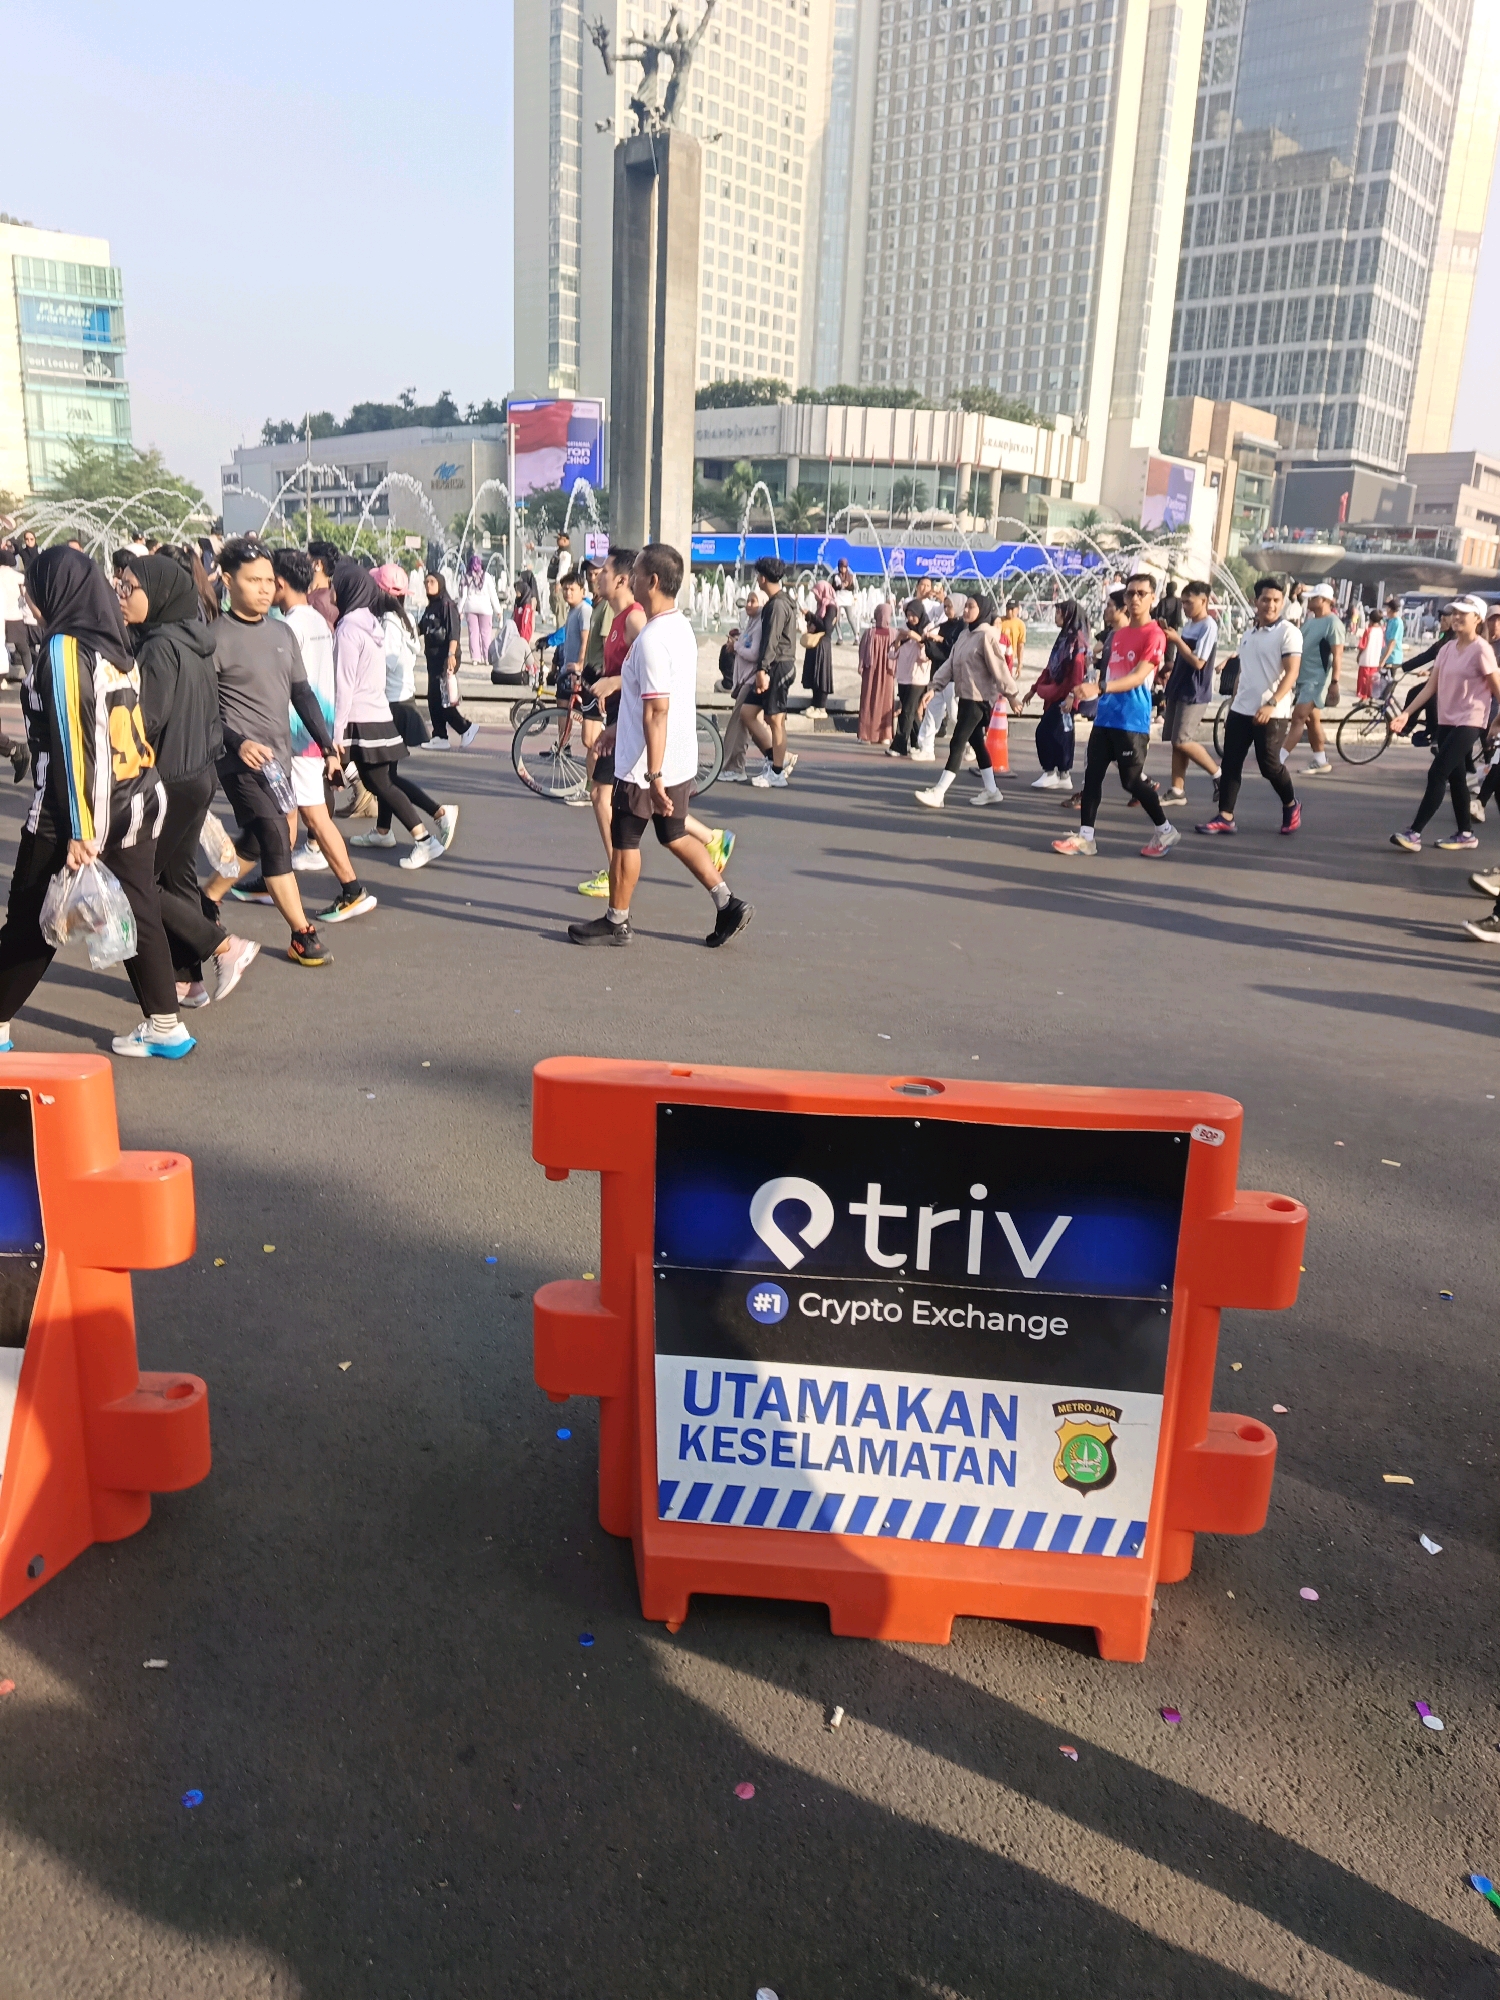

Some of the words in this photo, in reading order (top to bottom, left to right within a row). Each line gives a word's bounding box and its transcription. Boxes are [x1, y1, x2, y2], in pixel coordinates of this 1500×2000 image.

[738, 424, 776, 439] HYATT
[858, 531, 903, 546] PLAZA
[916, 556, 955, 567] Fastron
[849, 1183, 1073, 1279] triv
[753, 1292, 782, 1314] #1
[798, 1292, 903, 1326] Crypto
[912, 1300, 1069, 1340] Exchange
[683, 1369, 1019, 1441] UTAMAKAN
[1057, 1402, 1092, 1414] METRO
[1093, 1404, 1116, 1418] JAYA
[678, 1423, 1017, 1488] KESELAMATAN
